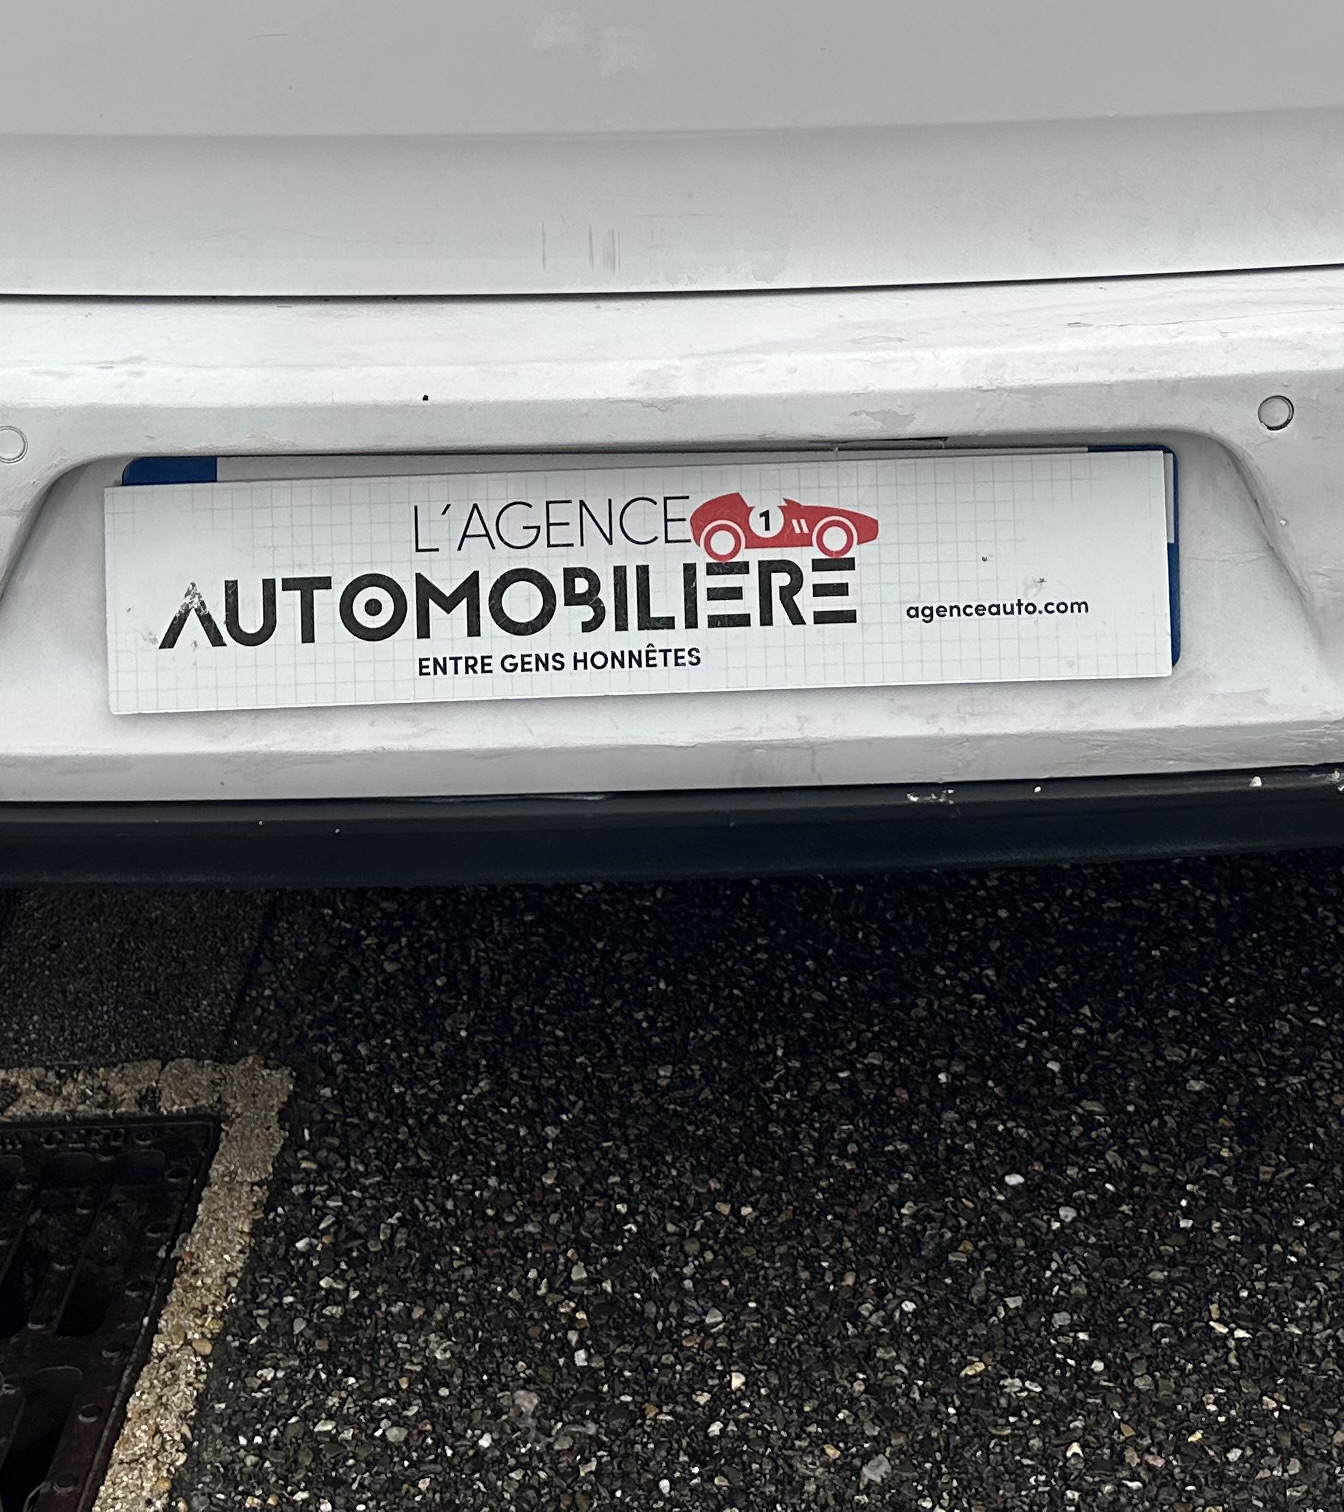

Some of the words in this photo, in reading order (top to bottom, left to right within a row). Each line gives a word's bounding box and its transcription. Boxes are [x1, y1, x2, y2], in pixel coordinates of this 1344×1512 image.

[413, 494, 692, 553] L'AGENCE
[758, 509, 772, 532] 1
[906, 598, 1090, 624] agenceauto.com
[418, 654, 493, 676] ENTRE
[500, 651, 566, 674] GENS
[573, 643, 702, 672] HONNÊTES
